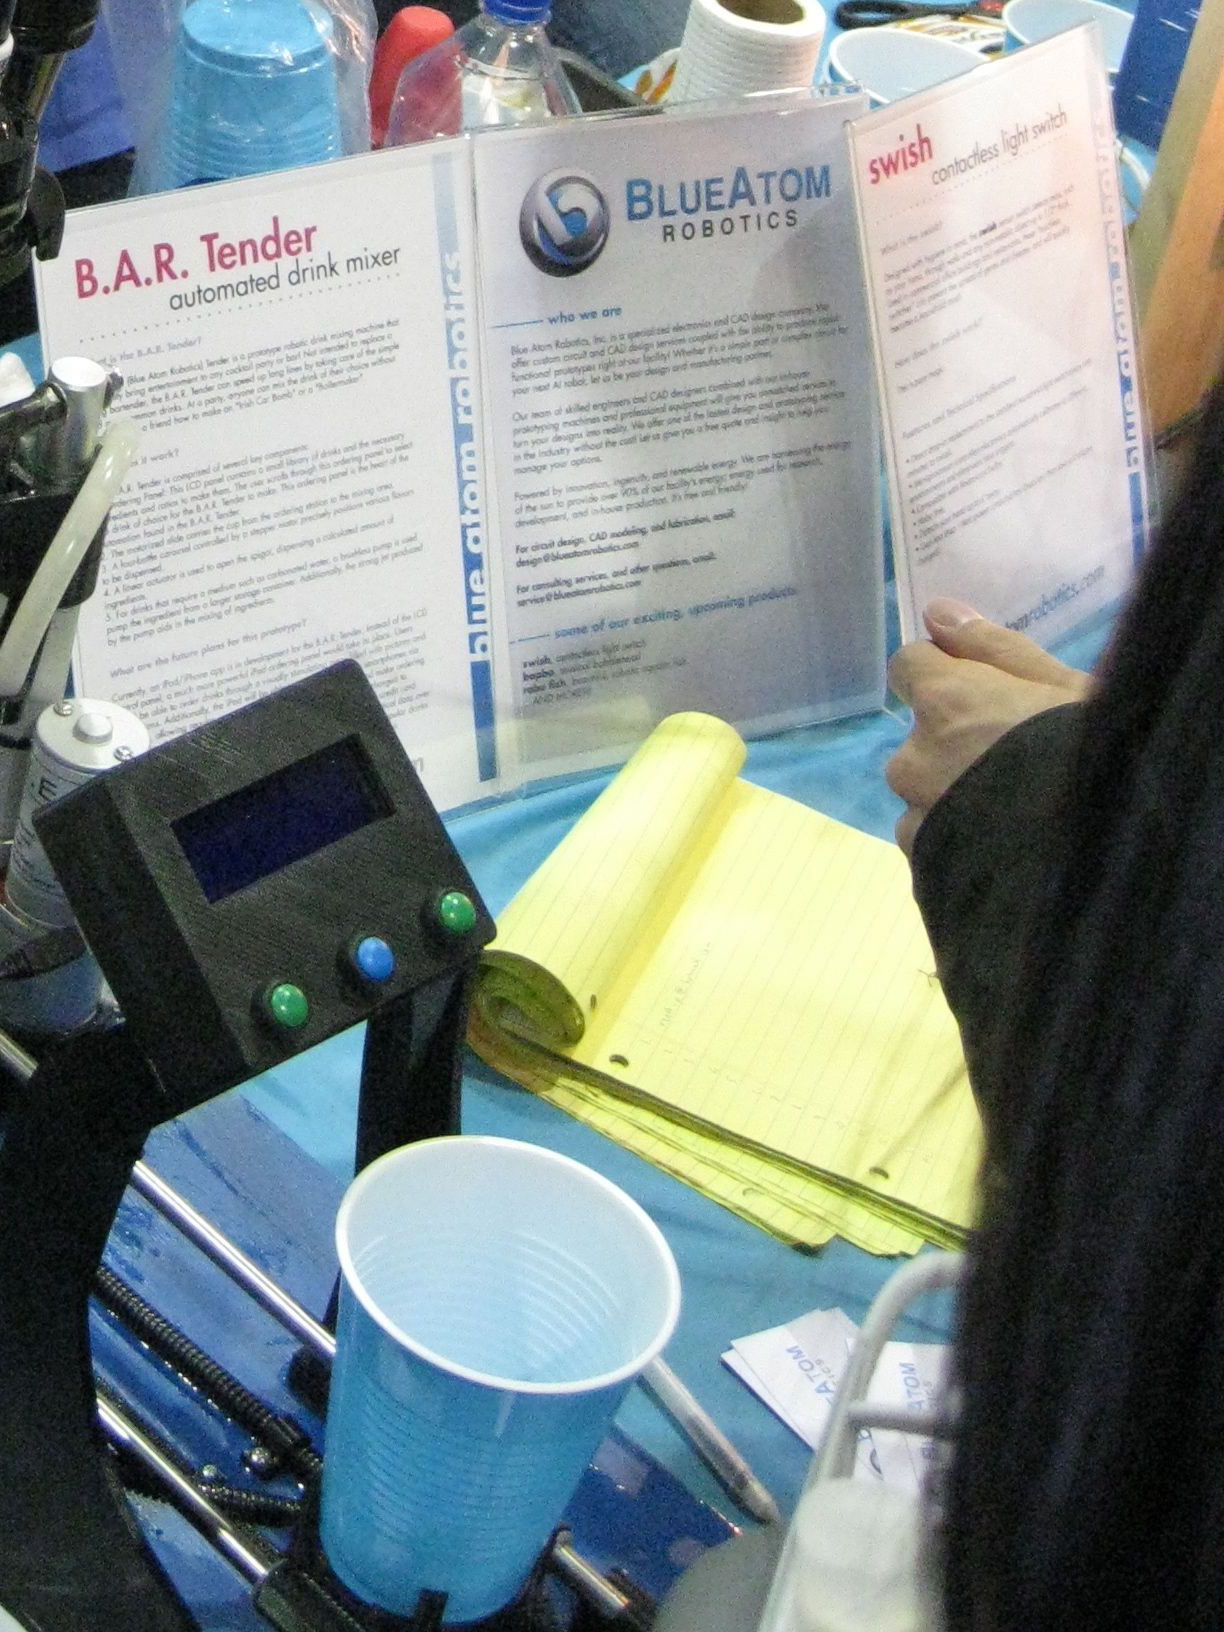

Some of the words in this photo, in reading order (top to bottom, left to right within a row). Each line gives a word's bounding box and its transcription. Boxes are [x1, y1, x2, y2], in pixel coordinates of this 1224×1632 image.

[869, 123, 933, 184] swish
[932, 140, 1000, 186] contactless
[1001, 122, 1029, 157] light
[1032, 103, 1068, 140] switch
[626, 164, 832, 221] BLUEATOM
[75, 241, 189, 299] B.A.R.
[200, 214, 318, 273] Tender
[662, 209, 799, 243] ROBOTICS
[170, 261, 281, 311] automated
[287, 251, 341, 287] drink
[345, 245, 402, 276] mixer
[546, 311, 577, 325] who
[580, 309, 599, 320] we
[602, 306, 623, 318] are
